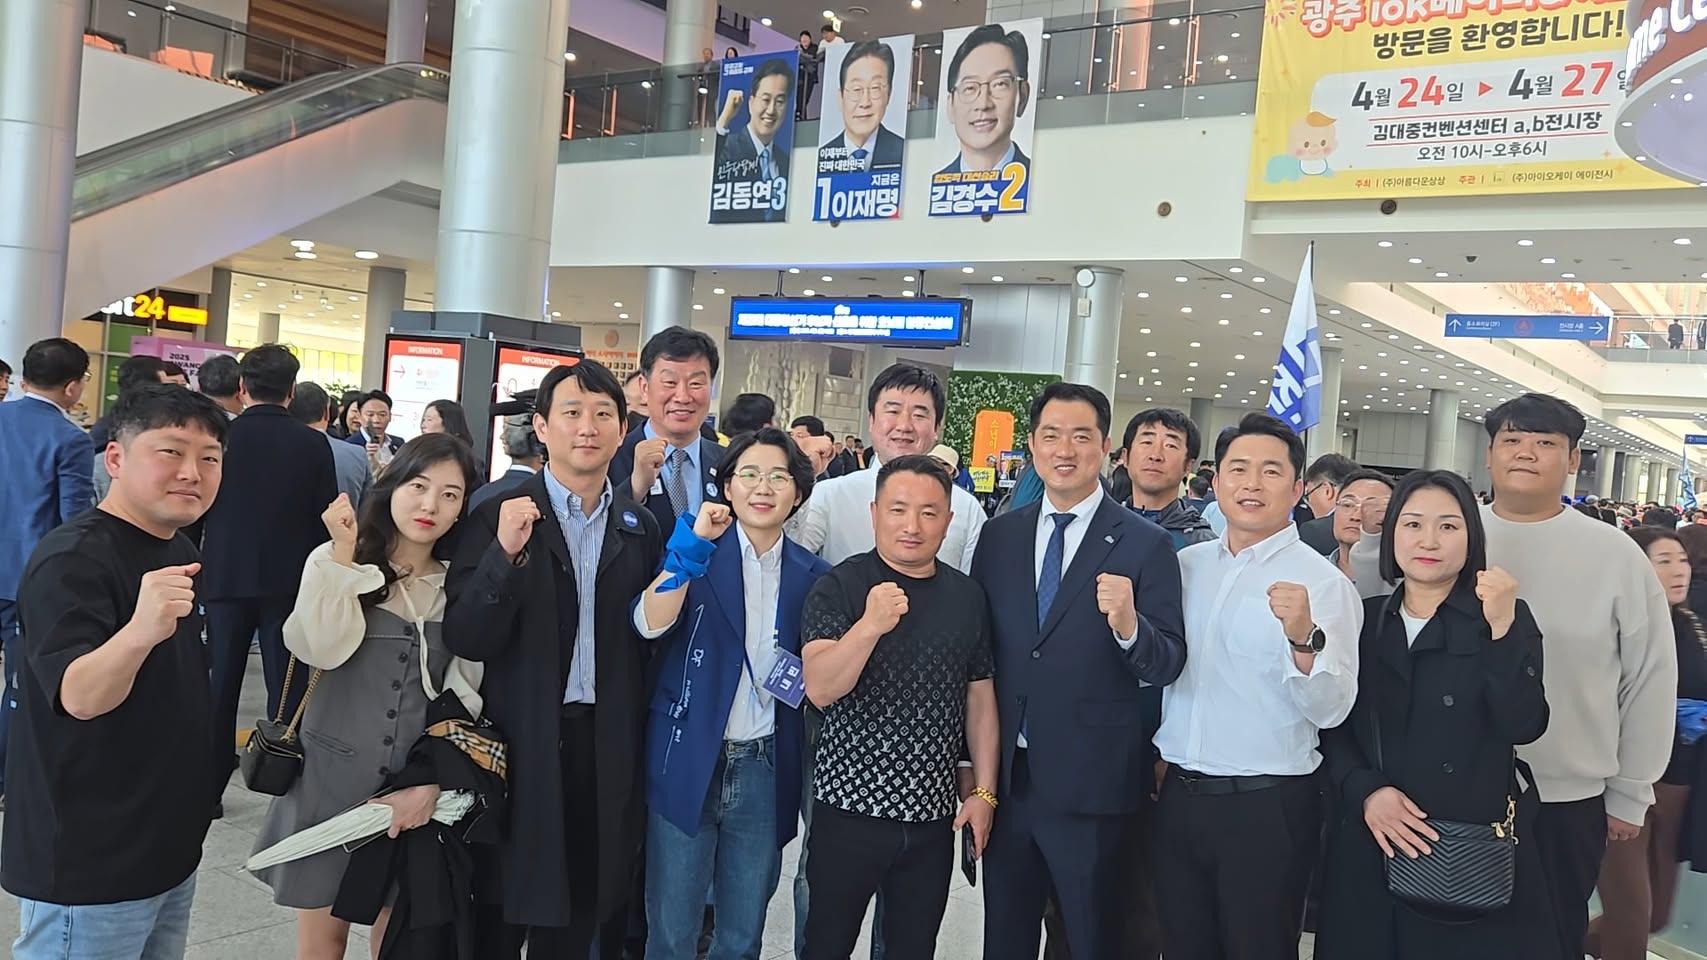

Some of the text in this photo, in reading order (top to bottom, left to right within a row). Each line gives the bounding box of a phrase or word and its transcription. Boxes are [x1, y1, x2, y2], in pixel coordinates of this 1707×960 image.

[1373, 9, 1625, 59] 방문을 환영합니다!
[1351, 81, 1391, 110] 4월
[1398, 75, 1464, 109] 24일
[1508, 68, 1553, 100] 4월
[1373, 111, 1603, 141] 김대중컨벤션센터 a,b전시장
[1416, 140, 1548, 161] 오전 10시-오후6시
[834, 158, 866, 172] 대한민국
[871, 173, 900, 186] 지금은
[408, 346, 443, 355] INFORMATION
[521, 355, 560, 366] INFORMATION
